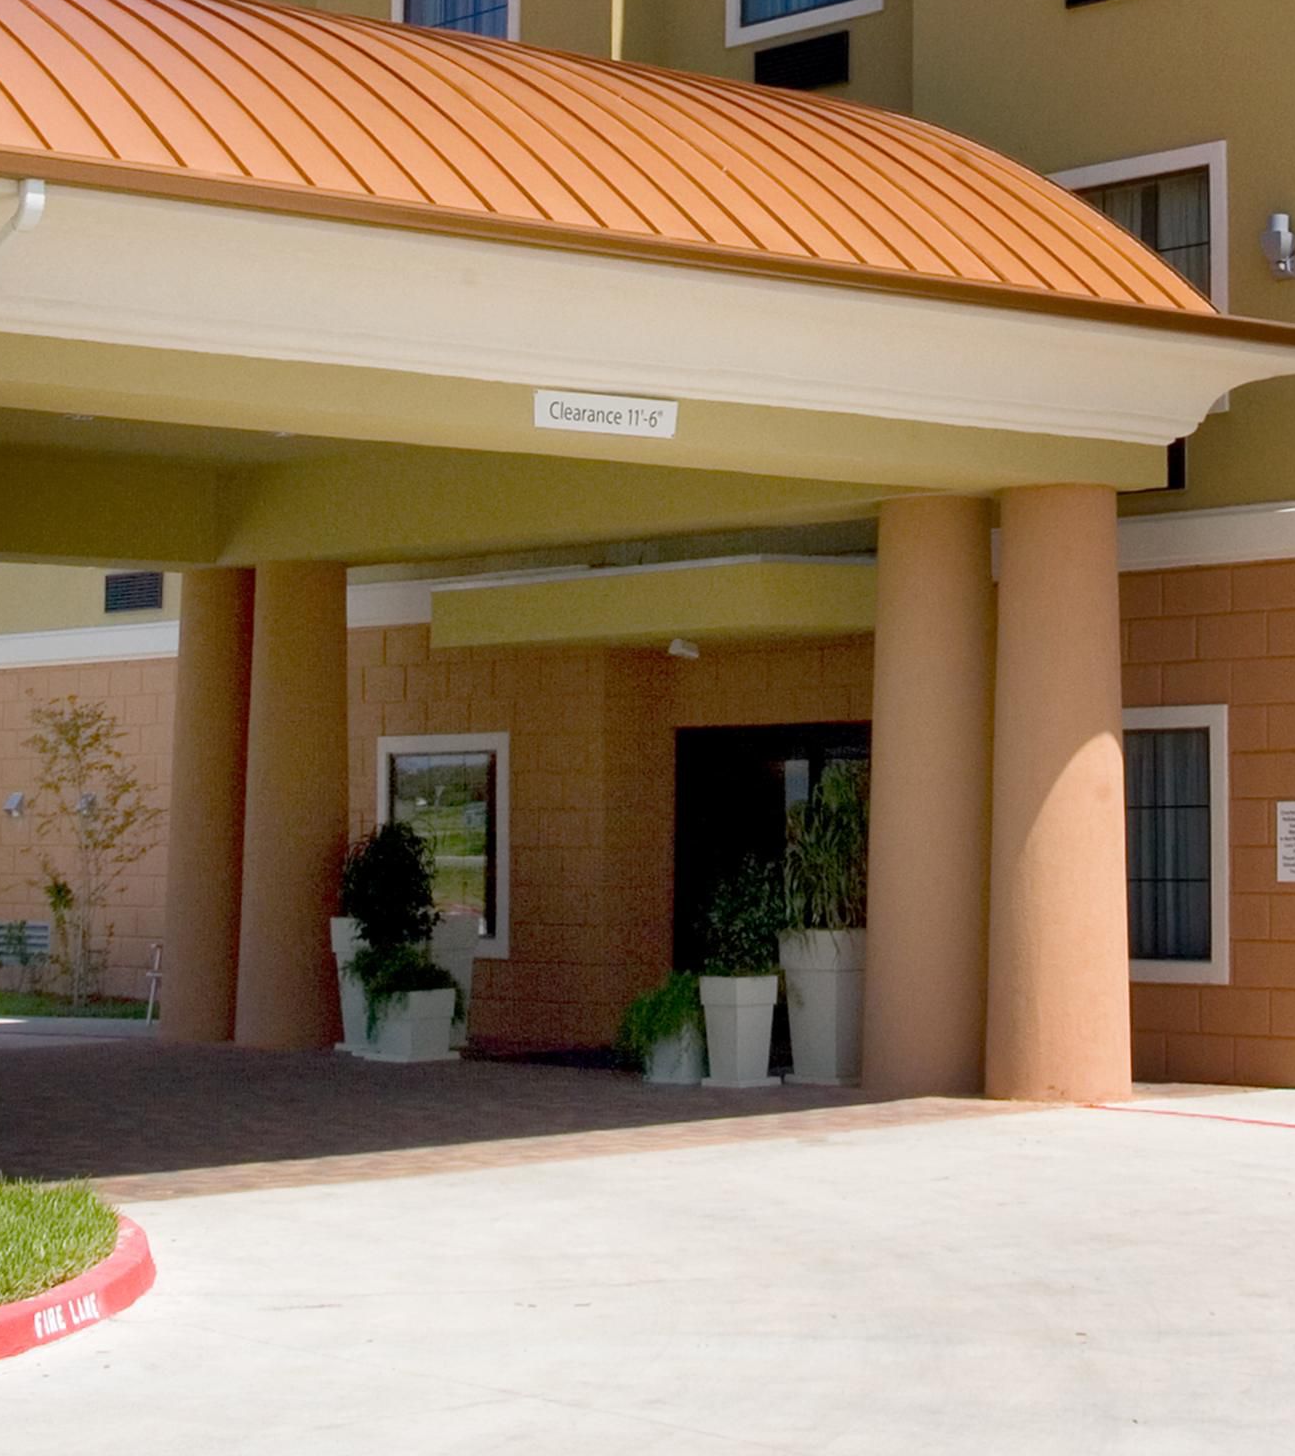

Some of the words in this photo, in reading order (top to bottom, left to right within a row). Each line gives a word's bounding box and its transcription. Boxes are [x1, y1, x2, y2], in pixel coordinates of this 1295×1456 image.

[548, 400, 623, 425] Clearance
[33, 1304, 66, 1339] FIRE
[68, 1292, 99, 1325] LANE
